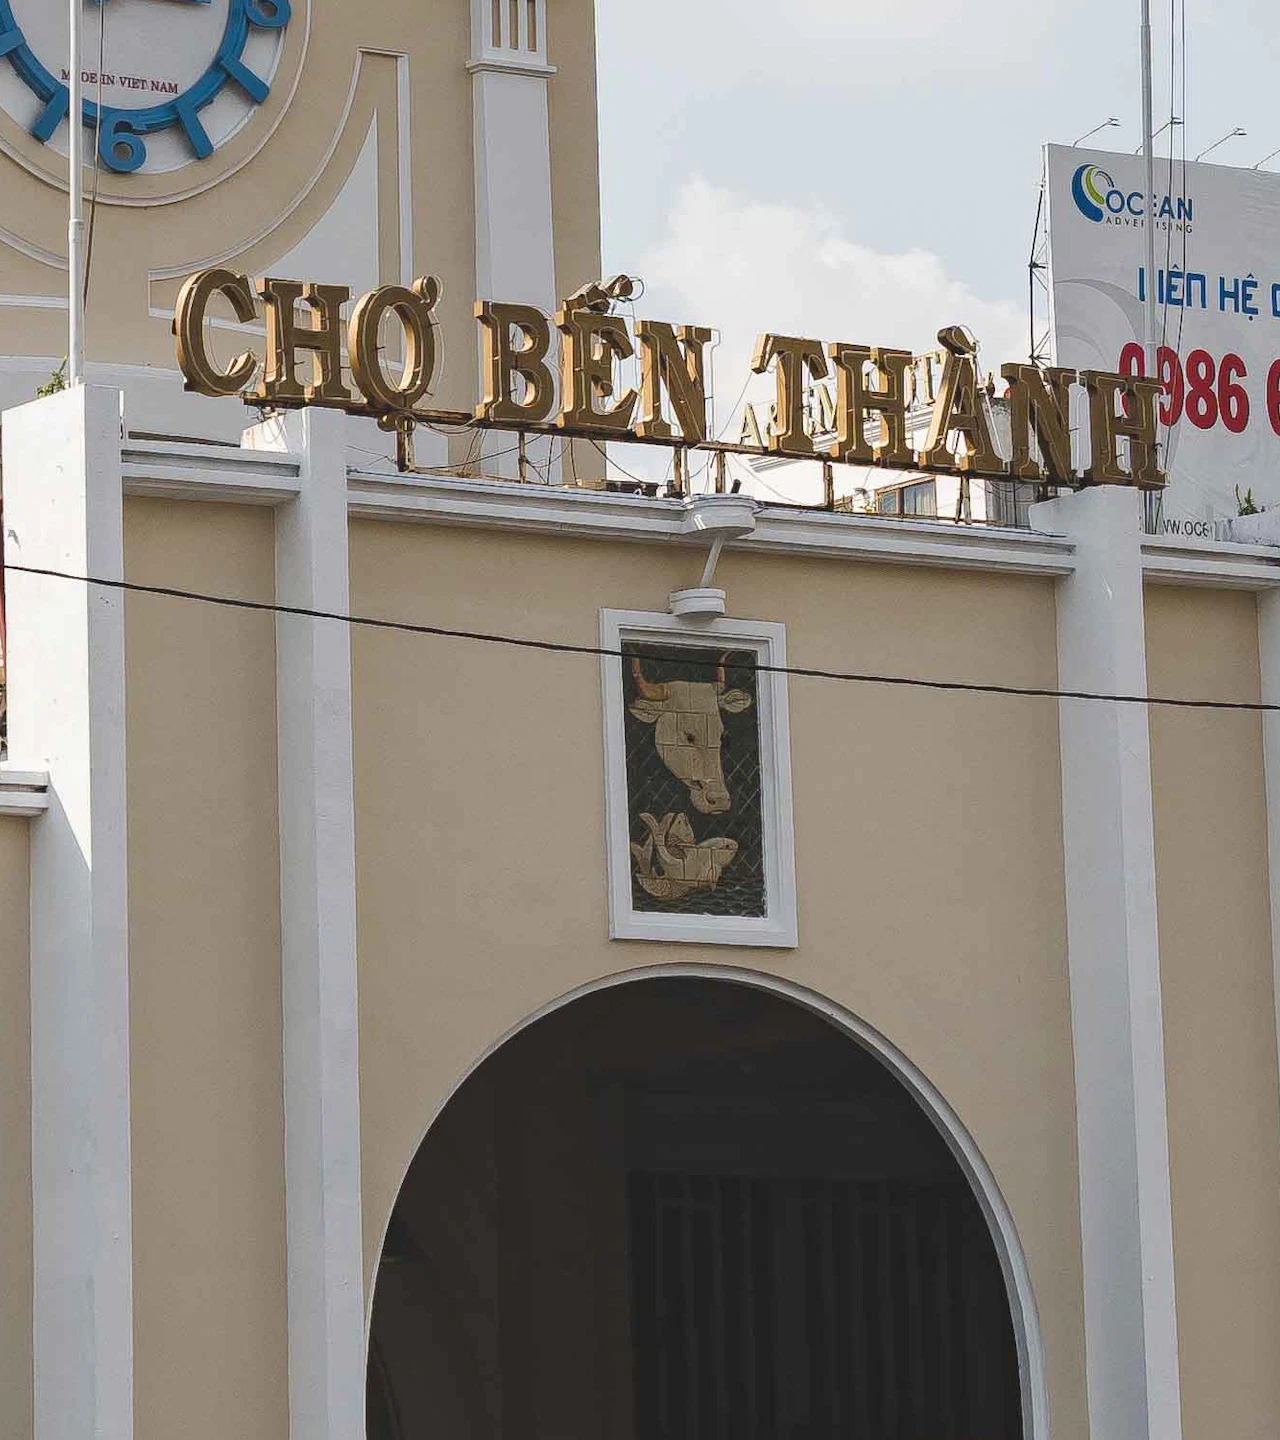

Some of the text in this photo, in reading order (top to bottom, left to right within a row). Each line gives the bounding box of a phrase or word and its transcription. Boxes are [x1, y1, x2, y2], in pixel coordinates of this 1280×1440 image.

[61, 69, 98, 83] MDE
[120, 76, 148, 90] VIET
[151, 80, 178, 94] NAM
[99, 118, 147, 174] 6
[1105, 189, 1193, 222] OCAN
[1219, 272, 1260, 322] HỆ
[175, 269, 444, 432] CHỢ
[473, 274, 713, 440] BẾN
[751, 324, 1170, 491] THÀNH
[1118, 342, 1250, 434] 0986
